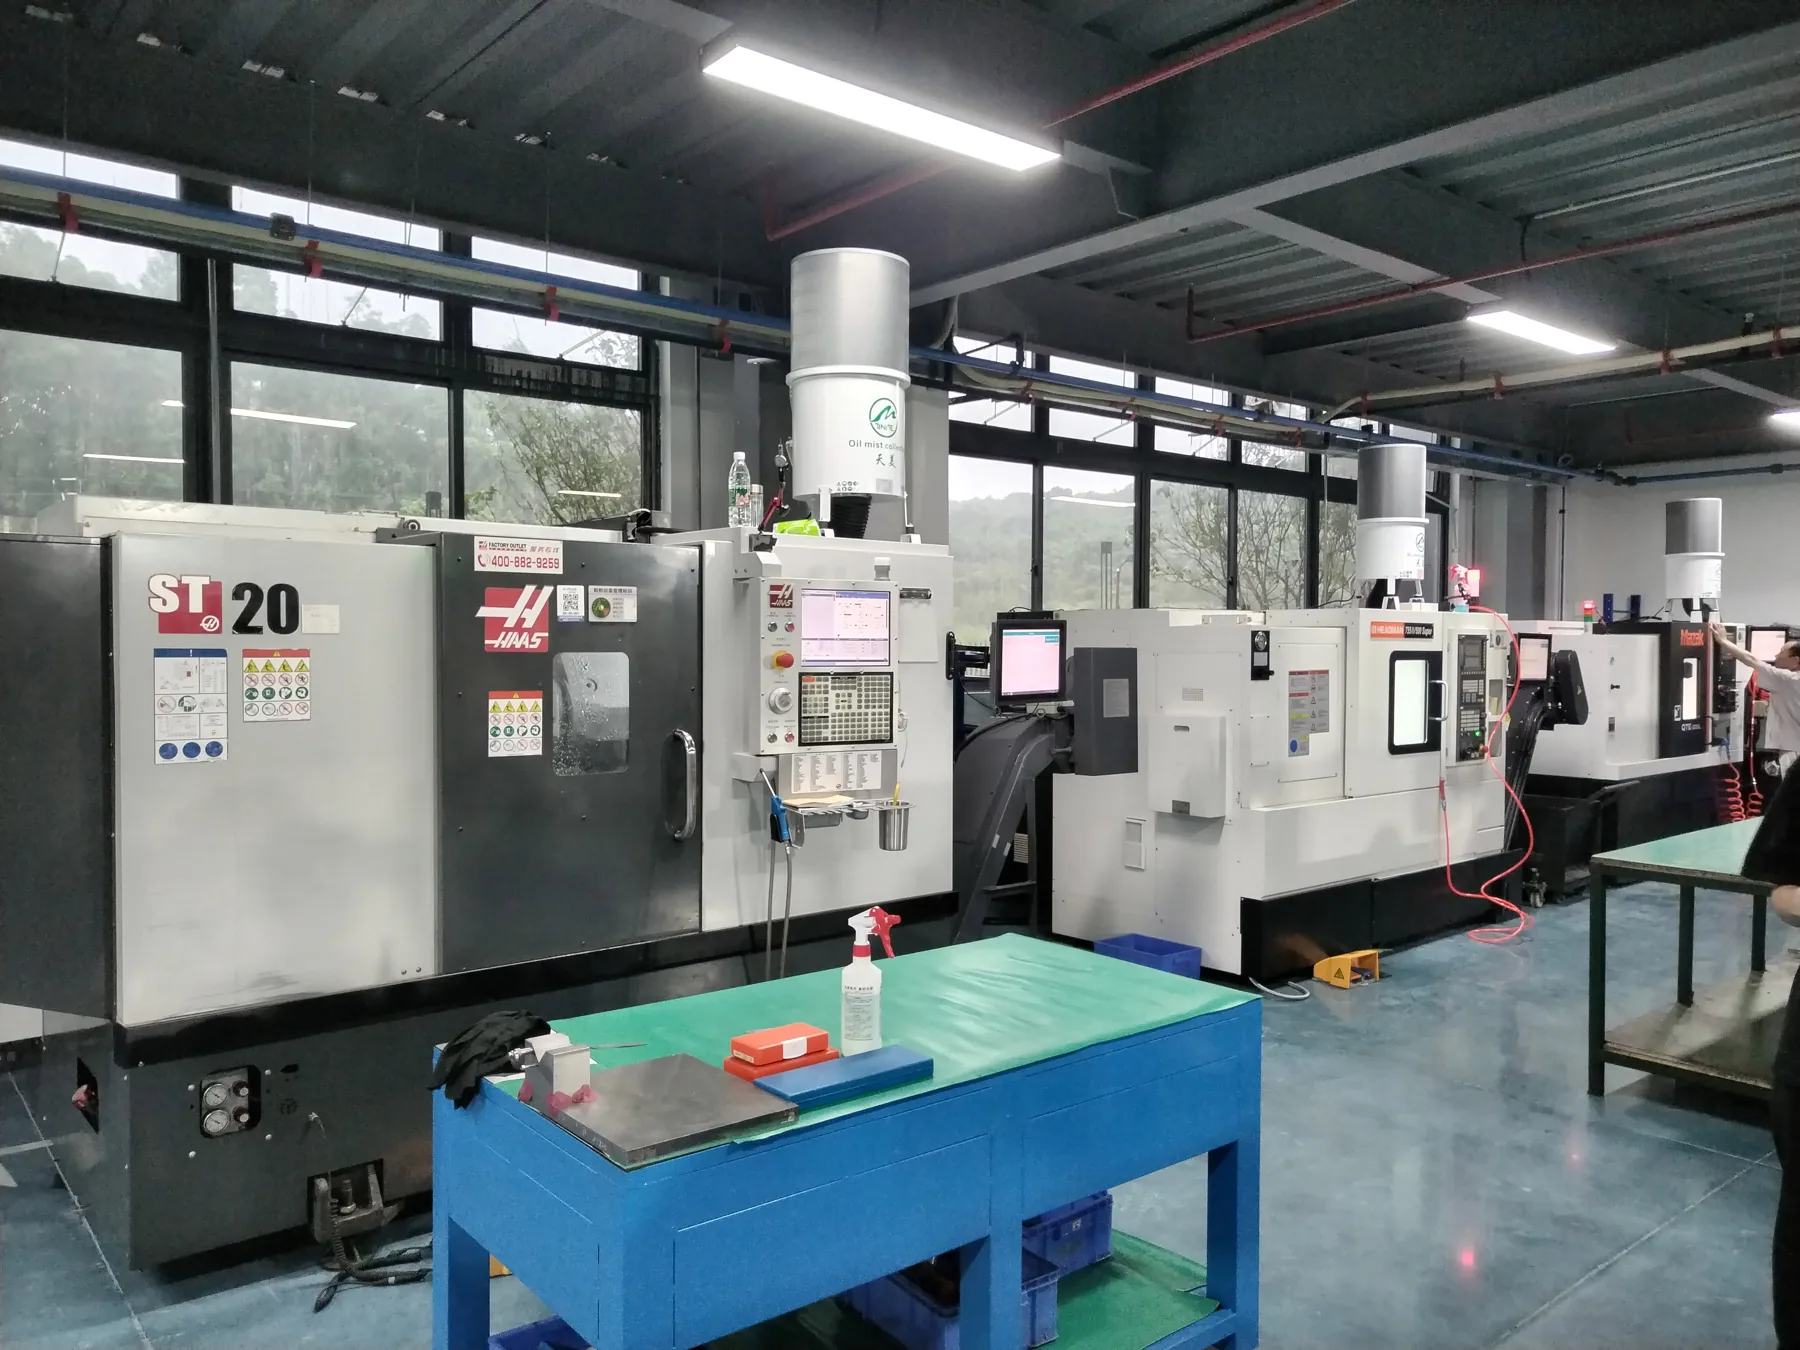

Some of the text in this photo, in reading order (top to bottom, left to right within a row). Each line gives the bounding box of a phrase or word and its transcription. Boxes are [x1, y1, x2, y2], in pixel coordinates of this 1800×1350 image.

[848, 439, 862, 448] Oil
[864, 441, 883, 449] mist
[491, 555, 560, 569] 400-882-9259
[148, 573, 300, 635] ST 20
[771, 599, 794, 607] HAAS
[485, 631, 549, 649] HAAS
[1680, 629, 1704, 646] Mazak
